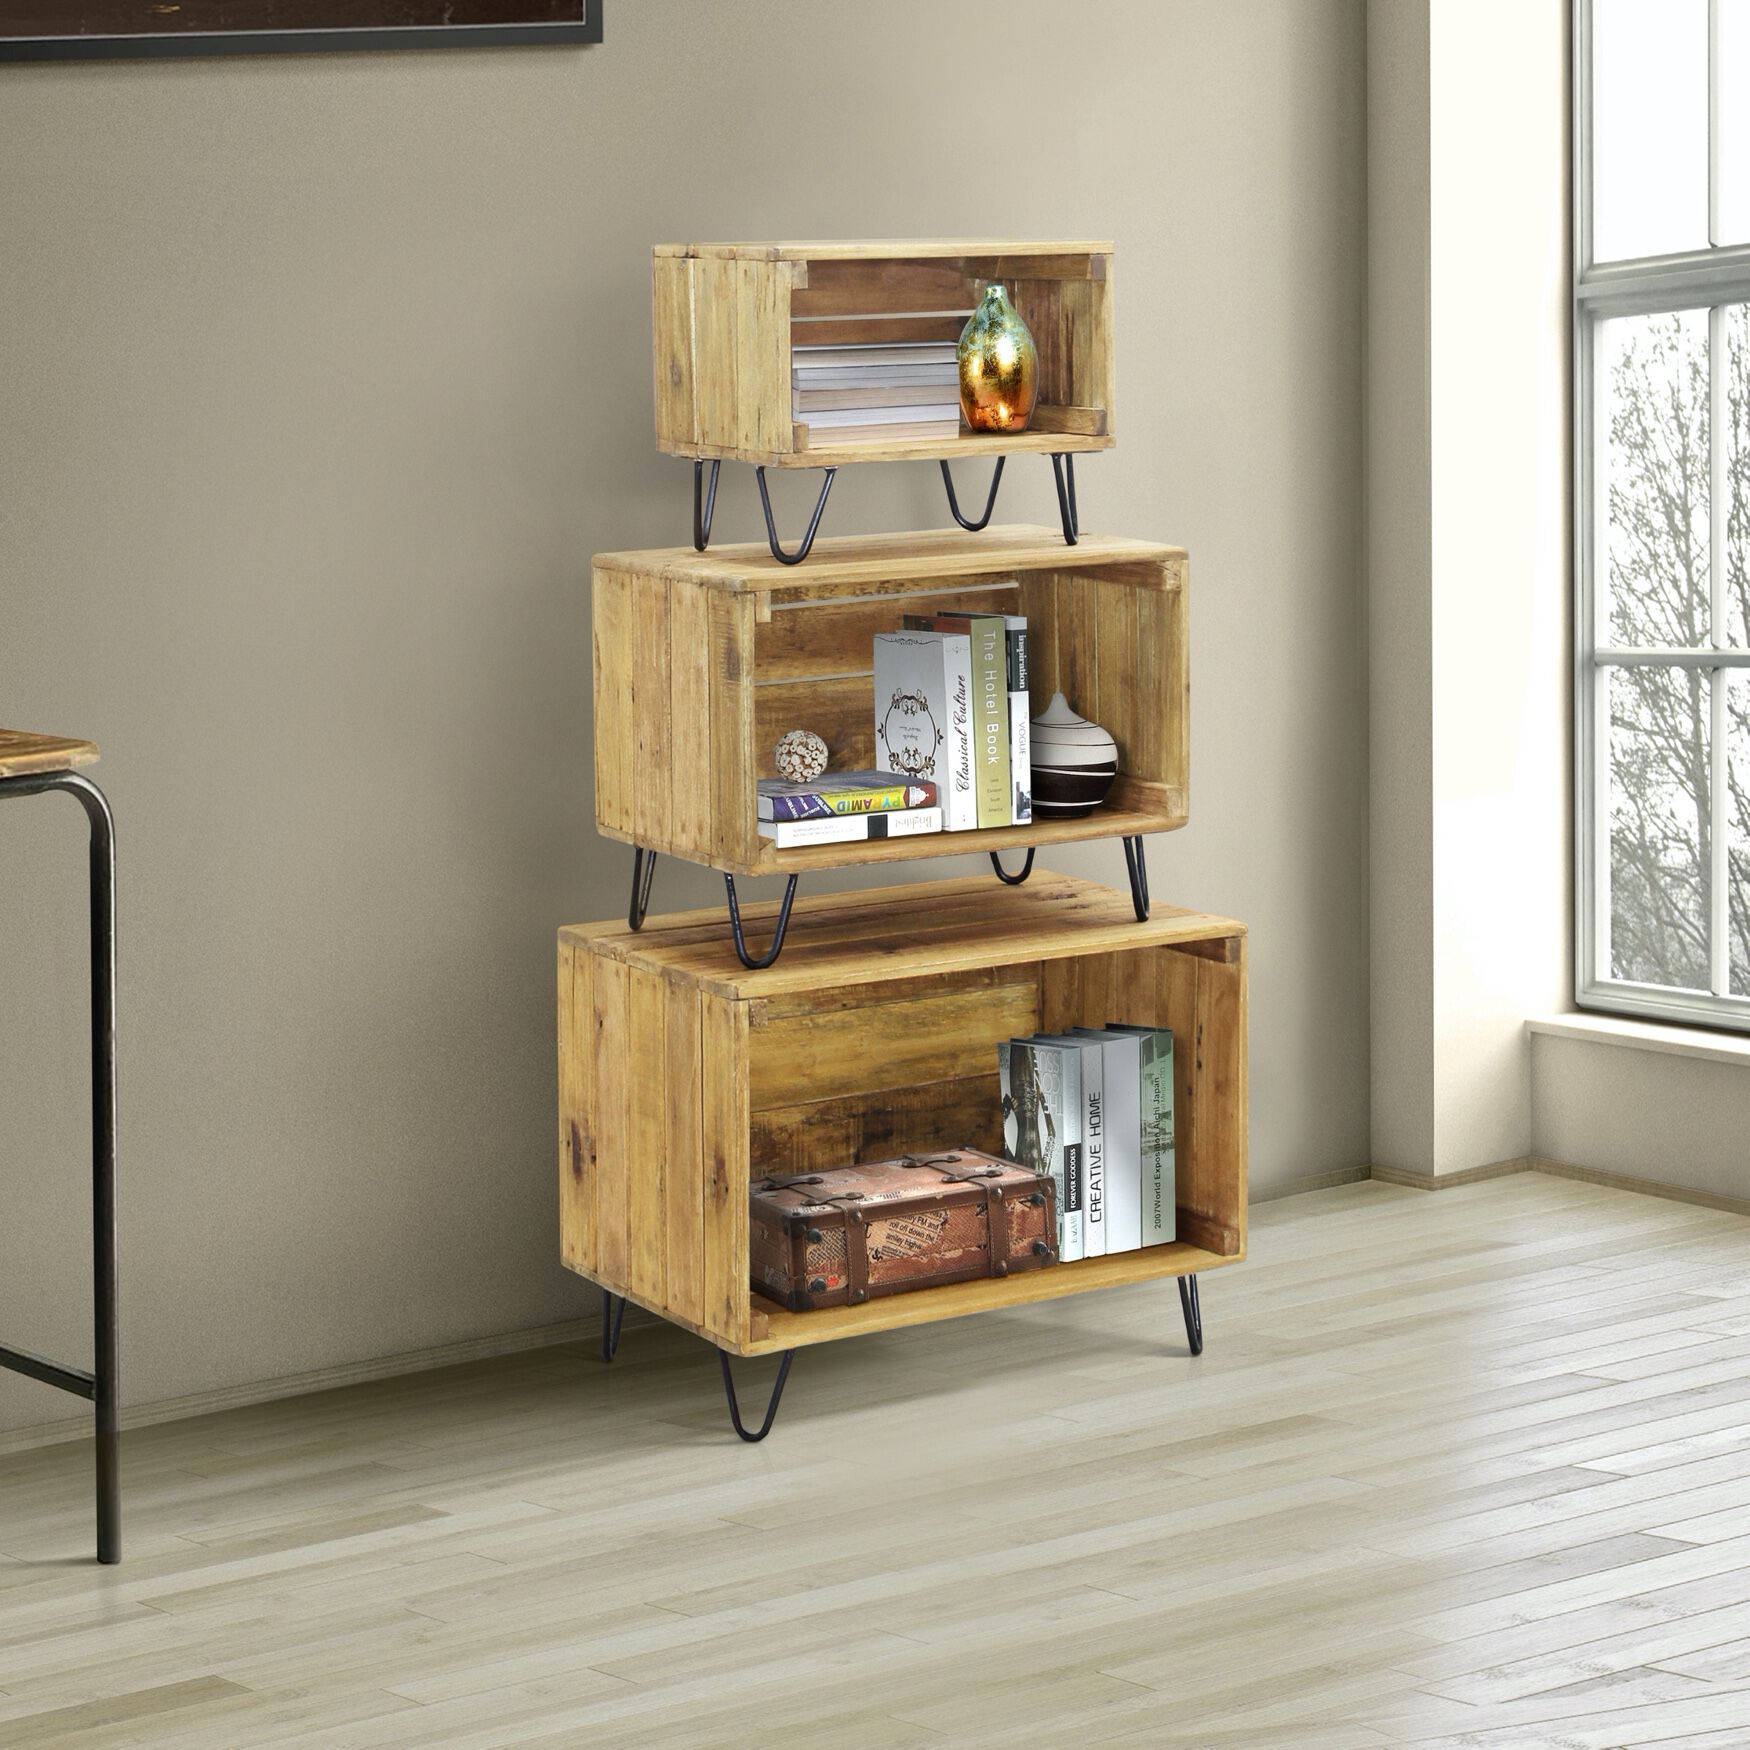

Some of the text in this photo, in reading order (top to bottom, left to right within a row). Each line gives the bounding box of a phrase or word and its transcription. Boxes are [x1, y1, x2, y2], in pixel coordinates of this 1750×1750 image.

[983, 630, 996, 661] The
[1016, 634, 1028, 689] inspiration
[984, 670, 999, 714] Hotel
[952, 673, 969, 793] Classical Culture
[987, 723, 1001, 765] Book
[1018, 721, 1027, 756] VOGUE
[837, 797, 901, 814] PYRAMID
[1152, 1077, 1161, 1104] Japan
[1152, 1106, 1160, 1130] Aichi
[1069, 1148, 1077, 1180] GODDESS
[1088, 1092, 1102, 1223] CREATIVE HOME
[908, 1226, 925, 1239] down
[928, 1221, 940, 1231] and
